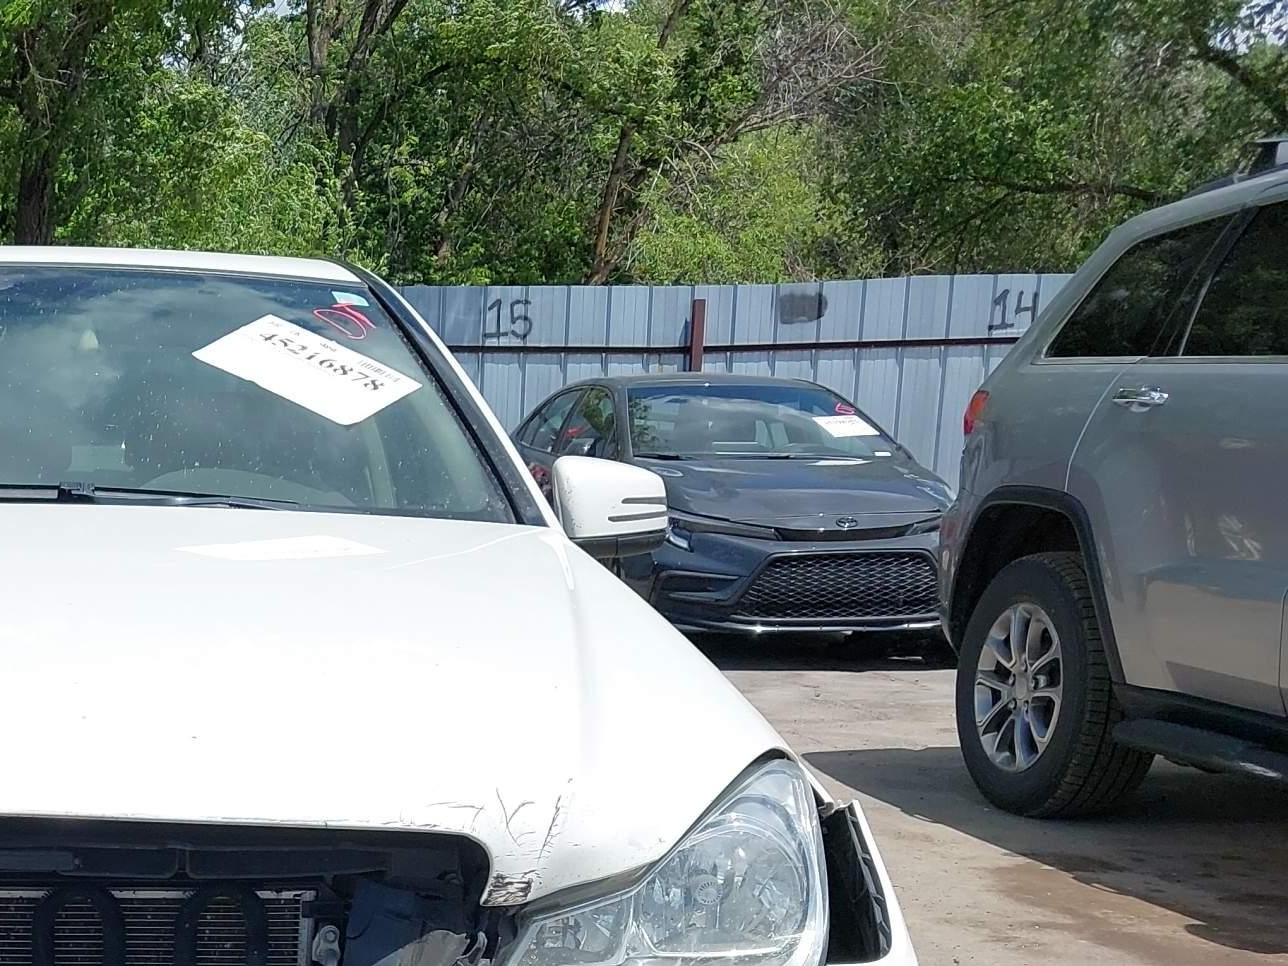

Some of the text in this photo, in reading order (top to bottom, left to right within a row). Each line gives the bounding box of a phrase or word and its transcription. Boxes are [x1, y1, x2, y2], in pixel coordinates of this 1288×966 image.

[484, 298, 533, 339] 15
[988, 289, 1039, 331] 14
[259, 331, 385, 391] 45216878
